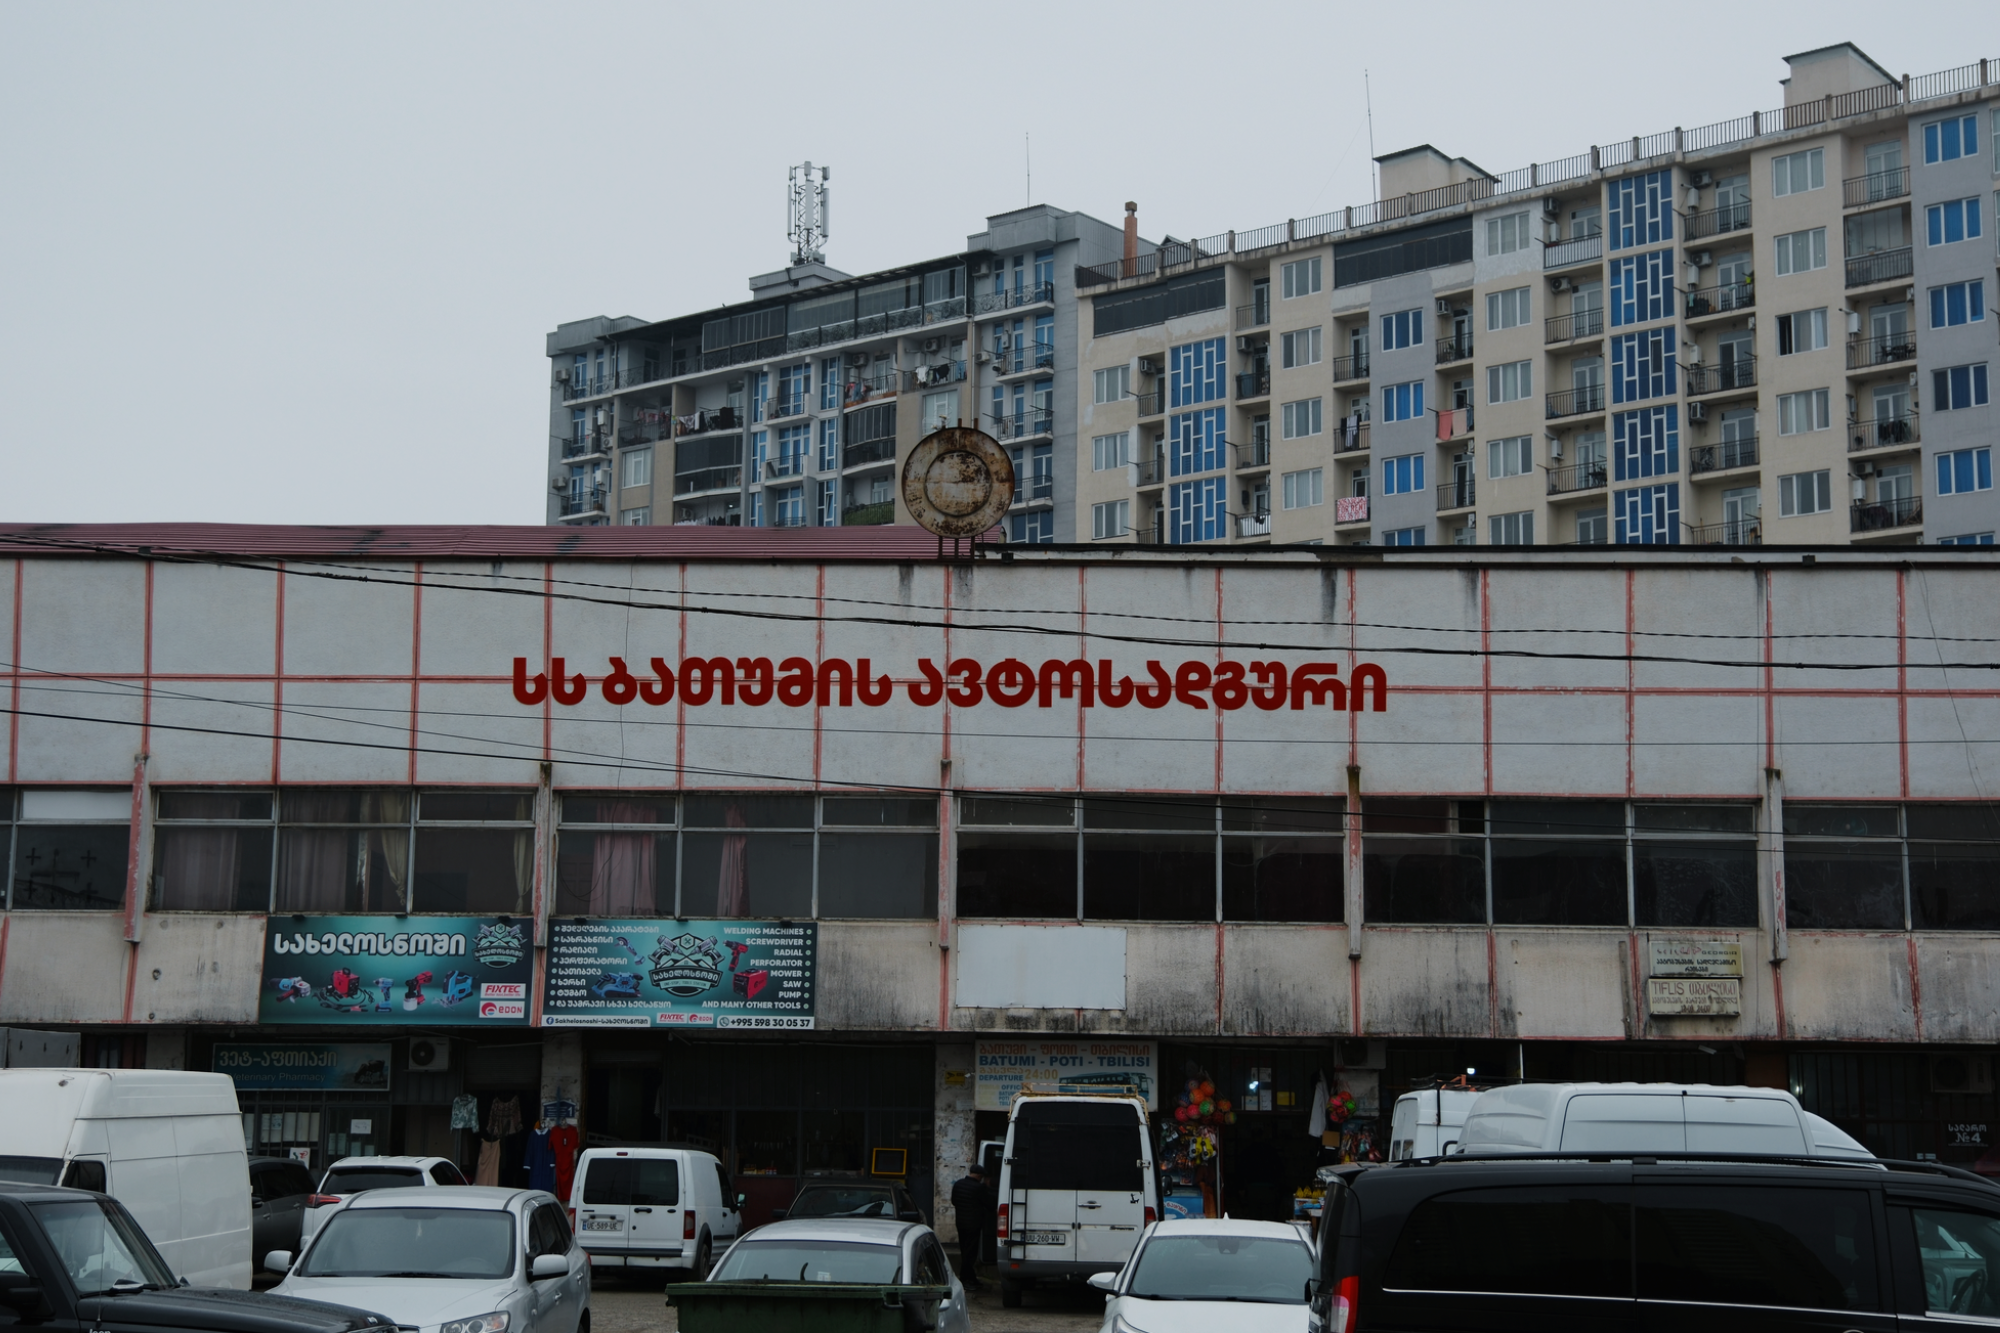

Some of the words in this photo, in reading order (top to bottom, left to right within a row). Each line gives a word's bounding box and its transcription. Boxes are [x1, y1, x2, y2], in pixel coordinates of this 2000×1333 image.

[513, 657, 585, 706] სს
[601, 656, 891, 707] ბათუმის
[908, 658, 1387, 712] ავტოსადგური
[611, 925, 659, 933] აპარატები
[723, 927, 761, 935] WELDING
[762, 927, 804, 935] MACHINES
[274, 932, 466, 956] სახელოსნოში
[560, 936, 613, 944] სახრახნისი
[745, 938, 804, 946] SCREWDRIVER
[559, 946, 598, 954] რადიალი
[774, 948, 803, 956] RADIAL
[750, 959, 803, 967] PERFORATOR
[558, 967, 602, 976] სათიბელა
[653, 969, 718, 981] სახელოსნოში
[770, 970, 802, 978] MOWER
[557, 978, 586, 986] ხერხი
[782, 980, 802, 988] SAW
[485, 985, 521, 993] FIXTEC
[1653, 982, 1685, 995] TIFLIS
[557, 989, 587, 997] ტუმბო
[778, 991, 802, 999] PUMP
[556, 1000, 566, 1008] და
[567, 1000, 605, 1008] უამრავი
[606, 1000, 627, 1008] სხვა
[628, 1001, 671, 1009] ხელსაწყო
[746, 1001, 773, 1009] OTHER
[774, 1001, 801, 1009] TOOLS
[730, 1018, 753, 1027] +995
[754, 1018, 771, 1027] 598
[772, 1018, 784, 1027] 30
[785, 1019, 798, 1027] 05
[799, 1019, 811, 1027] 37
[979, 1043, 1027, 1055] ბათუმი
[1040, 1044, 1077, 1055] ფოთი
[1090, 1044, 1150, 1056] თბილისი
[219, 1051, 337, 1067] ვეტ-აფთიაქი
[979, 1055, 1036, 1066] BATUMI
[1049, 1056, 1084, 1066] POTI
[1097, 1056, 1150, 1067] TBILISI
[279, 1072, 326, 1083] Pharmacy
[1024, 1068, 1058, 1080] 24:00
[567, 1106, 573, 1117] 1
[1948, 1123, 1987, 1132] სალარო
